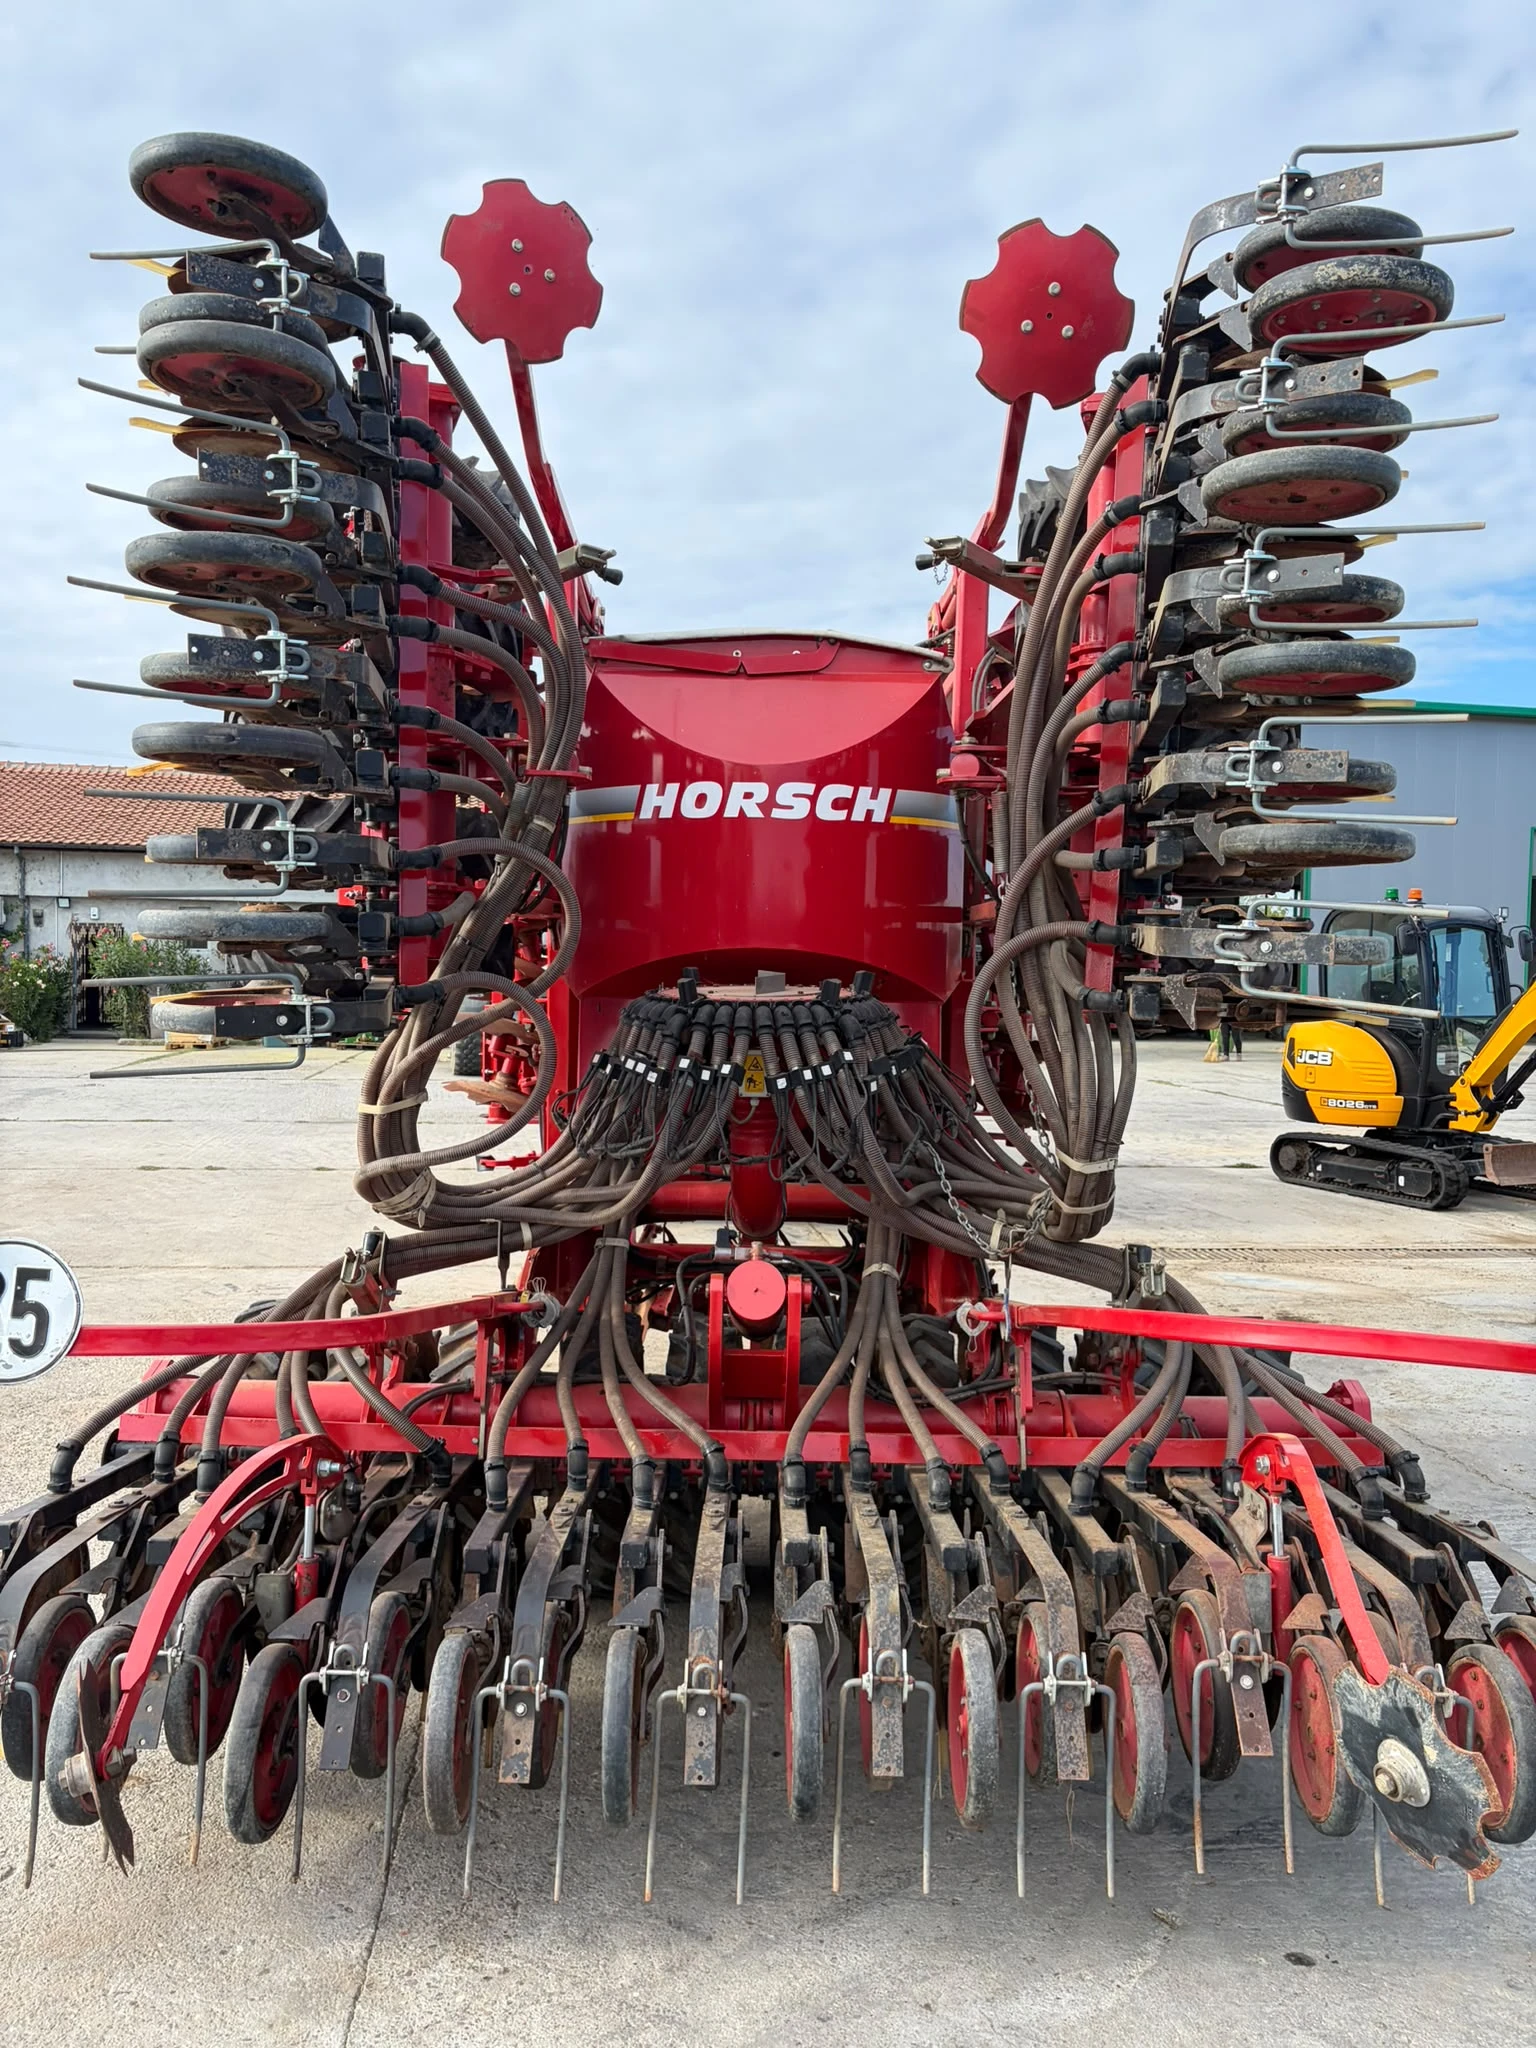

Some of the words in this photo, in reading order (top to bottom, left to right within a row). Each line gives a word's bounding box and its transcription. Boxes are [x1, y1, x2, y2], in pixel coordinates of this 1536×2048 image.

[639, 781, 892, 823] HORSCH
[1296, 1049, 1332, 1065] JCB
[0, 1266, 51, 1359] 5
